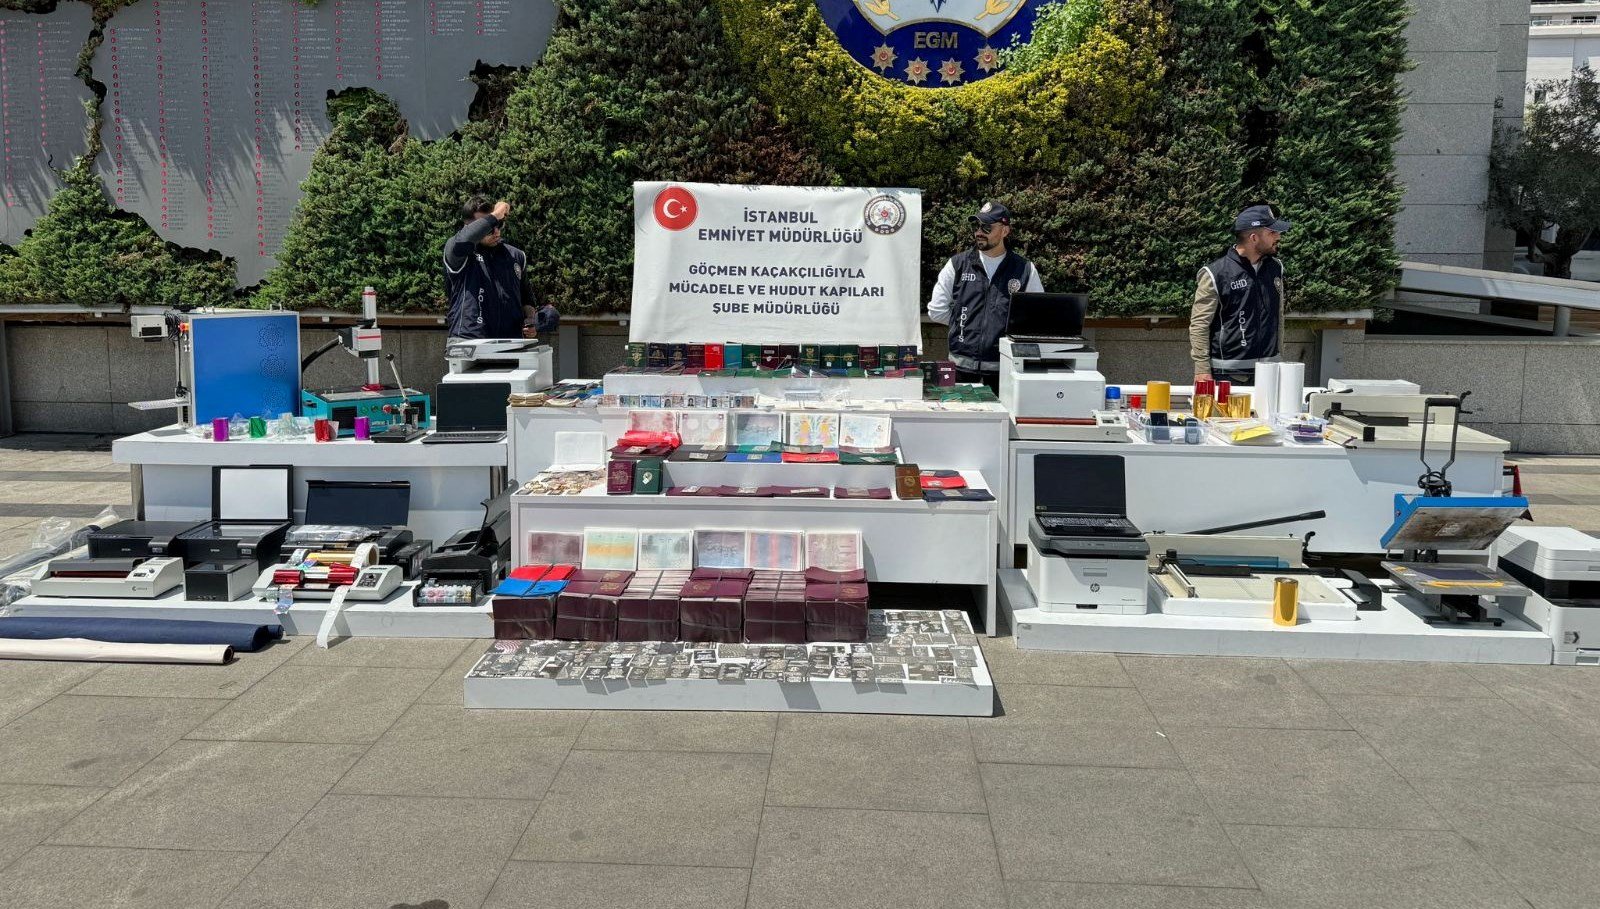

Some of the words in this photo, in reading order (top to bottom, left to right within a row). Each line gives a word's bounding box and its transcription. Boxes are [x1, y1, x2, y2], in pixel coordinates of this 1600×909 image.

[914, 31, 958, 49] EGM
[743, 207, 819, 224] İSTANBUL
[698, 226, 765, 243] EMNİYET
[769, 229, 863, 244] MÜDÜRLÜĞÜ
[688, 263, 747, 277] GÖÇMEN
[751, 265, 866, 279] KAÇAKÇILIĞIYLA
[669, 281, 745, 296] MÜCADELE
[748, 284, 766, 296] VE
[769, 285, 816, 297] HUDUT
[819, 286, 885, 298] KAPILARI
[1230, 279, 1247, 290] GHD
[712, 302, 750, 315] ŞUBE
[753, 302, 840, 316] MÜDÜRLÜĞÜ
